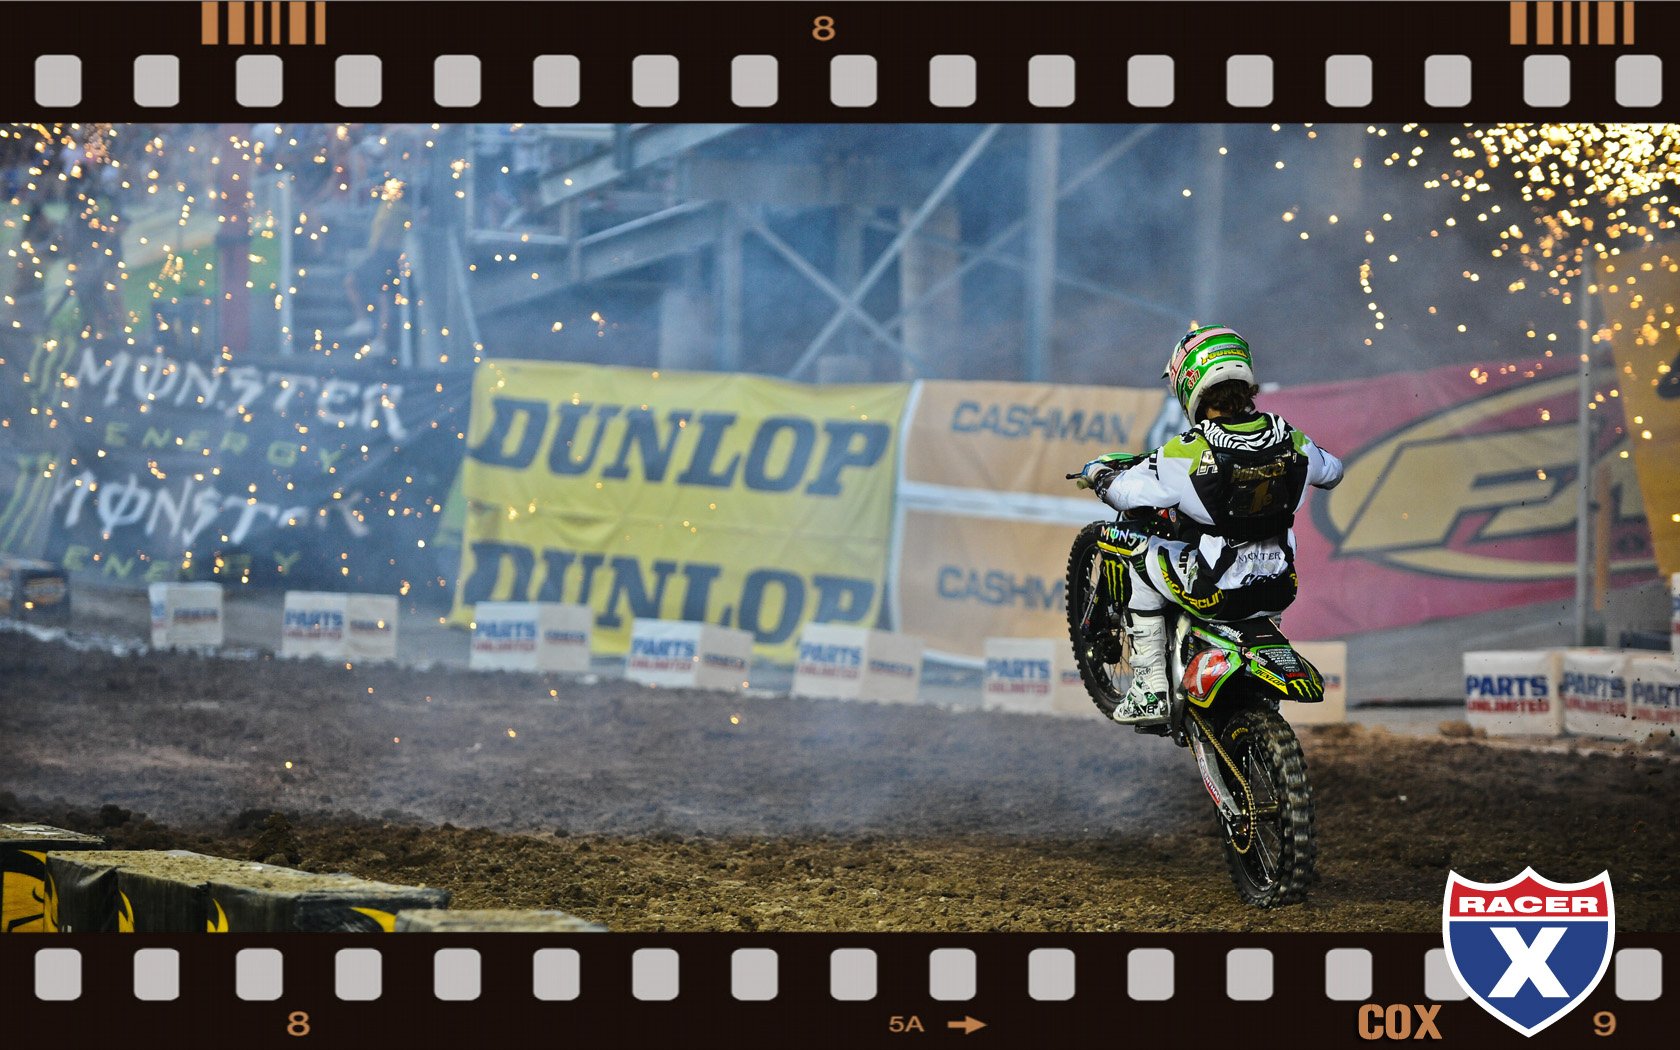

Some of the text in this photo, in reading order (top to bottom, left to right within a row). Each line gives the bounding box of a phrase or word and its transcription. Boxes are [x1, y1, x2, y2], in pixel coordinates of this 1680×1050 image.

[76, 347, 406, 440] MONSTER
[467, 397, 891, 496] DUNLOP
[950, 400, 1137, 447] CASHMAN
[105, 421, 343, 474] ENERGY
[1239, 550, 1282, 564] MONTER
[460, 541, 877, 646] DUNLOP
[1255, 669, 1286, 688] DUNLOP
[1465, 673, 1549, 697] PARTS
[1466, 698, 1551, 715] UNLIMITED
